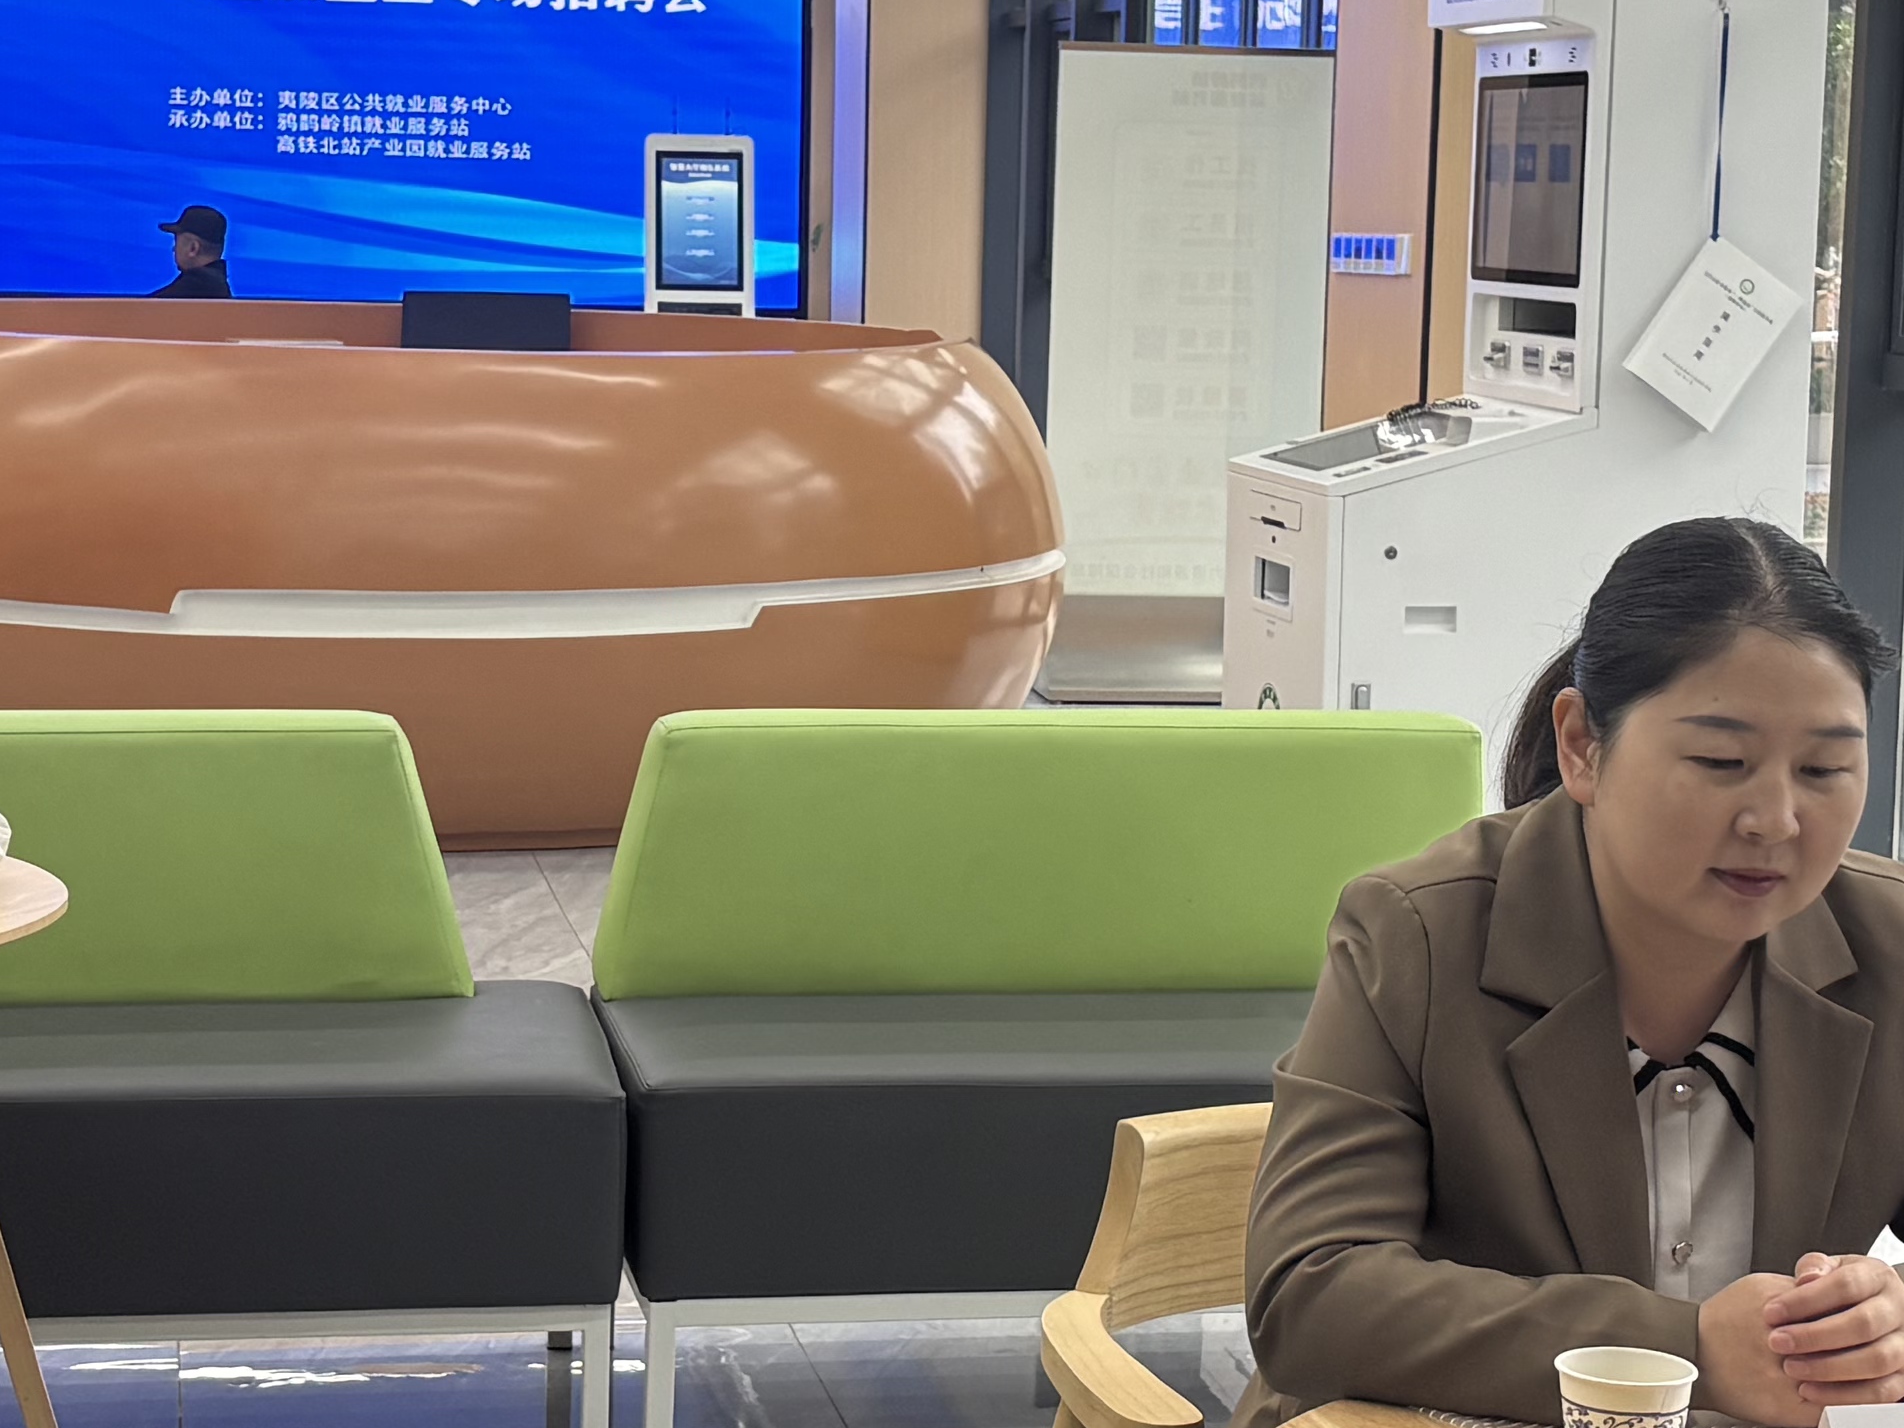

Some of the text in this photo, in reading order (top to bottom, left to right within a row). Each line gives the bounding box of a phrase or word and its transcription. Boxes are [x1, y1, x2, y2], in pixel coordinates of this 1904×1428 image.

[276, 134, 531, 161] 高铁北站产业园就业服务站
